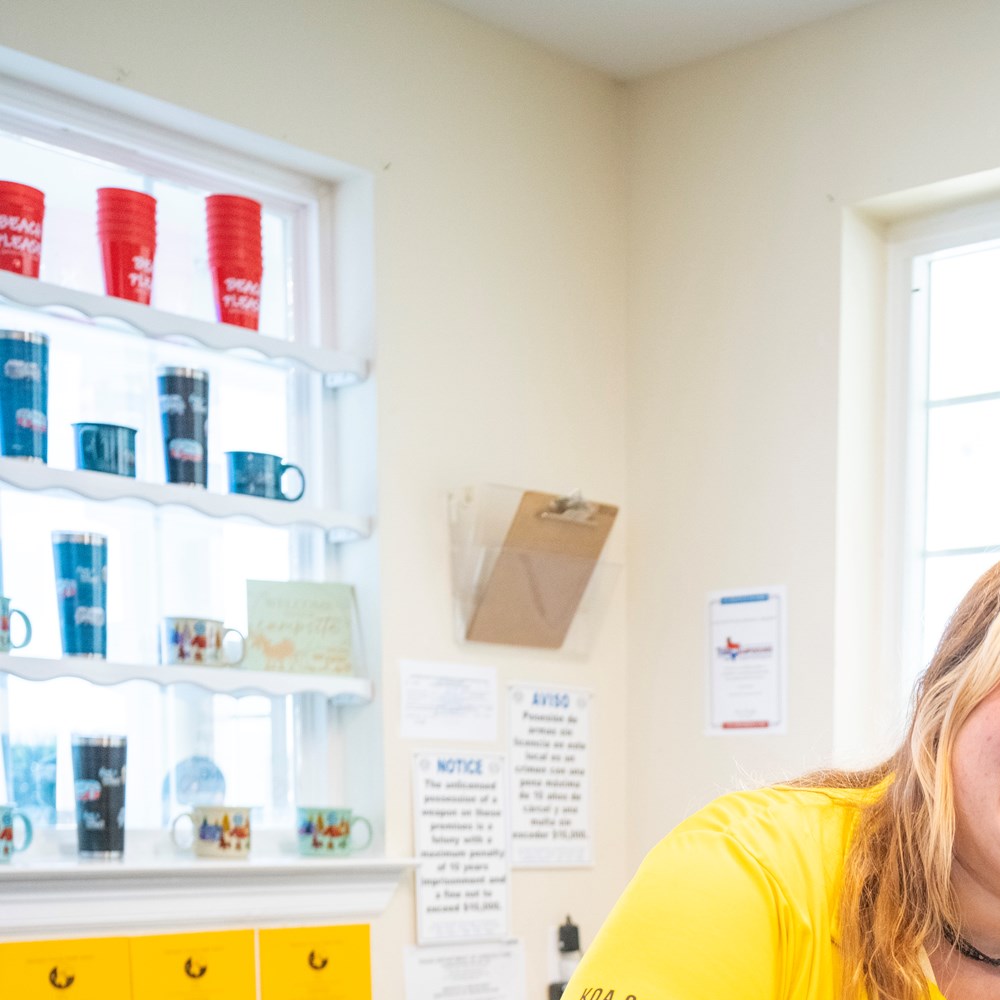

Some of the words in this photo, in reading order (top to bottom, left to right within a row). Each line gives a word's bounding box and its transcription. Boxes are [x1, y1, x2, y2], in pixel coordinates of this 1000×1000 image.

[532, 692, 570, 708] AVISO
[437, 759, 482, 775] NOTICE
[425, 779, 441, 789] The
